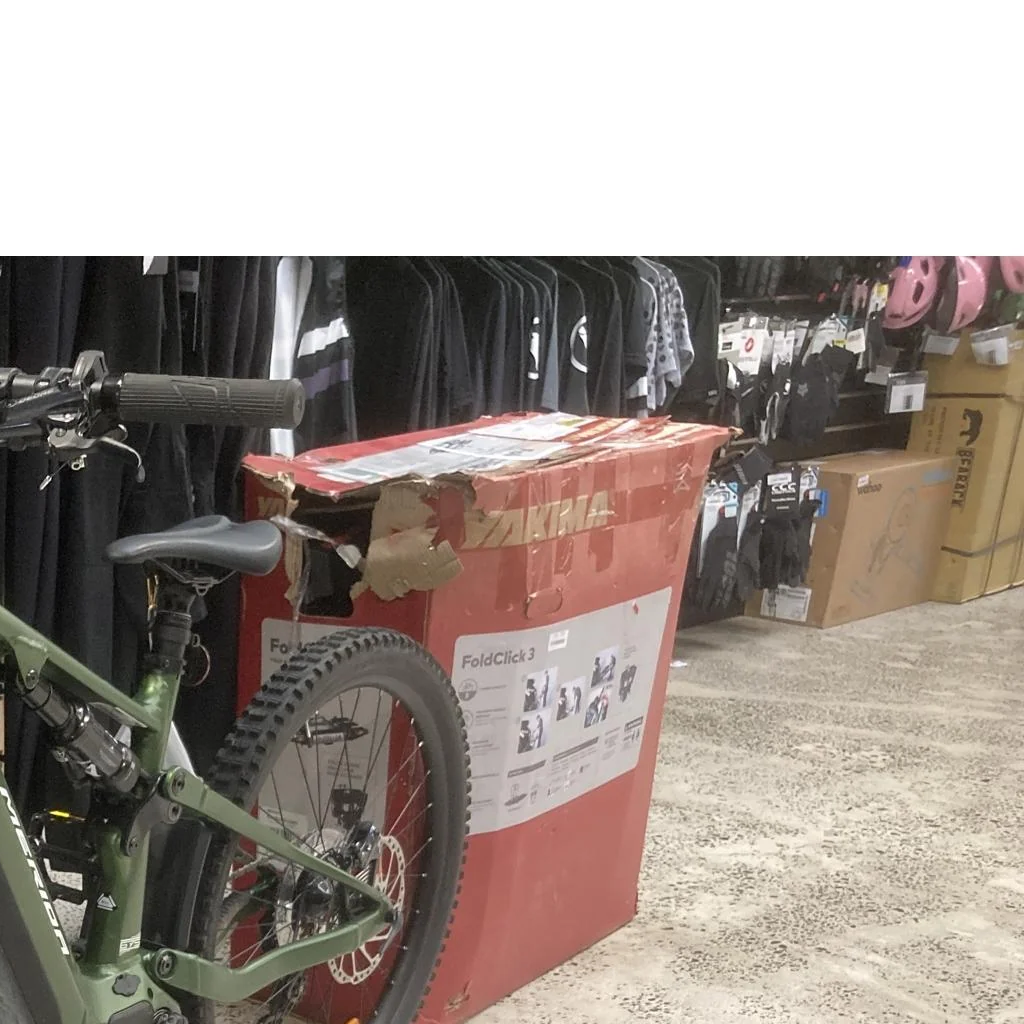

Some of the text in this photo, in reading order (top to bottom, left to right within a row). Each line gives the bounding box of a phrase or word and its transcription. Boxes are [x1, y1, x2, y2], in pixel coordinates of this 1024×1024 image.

[460, 490, 609, 549] YAKIMA
[461, 647, 536, 669] FoldClick 3
